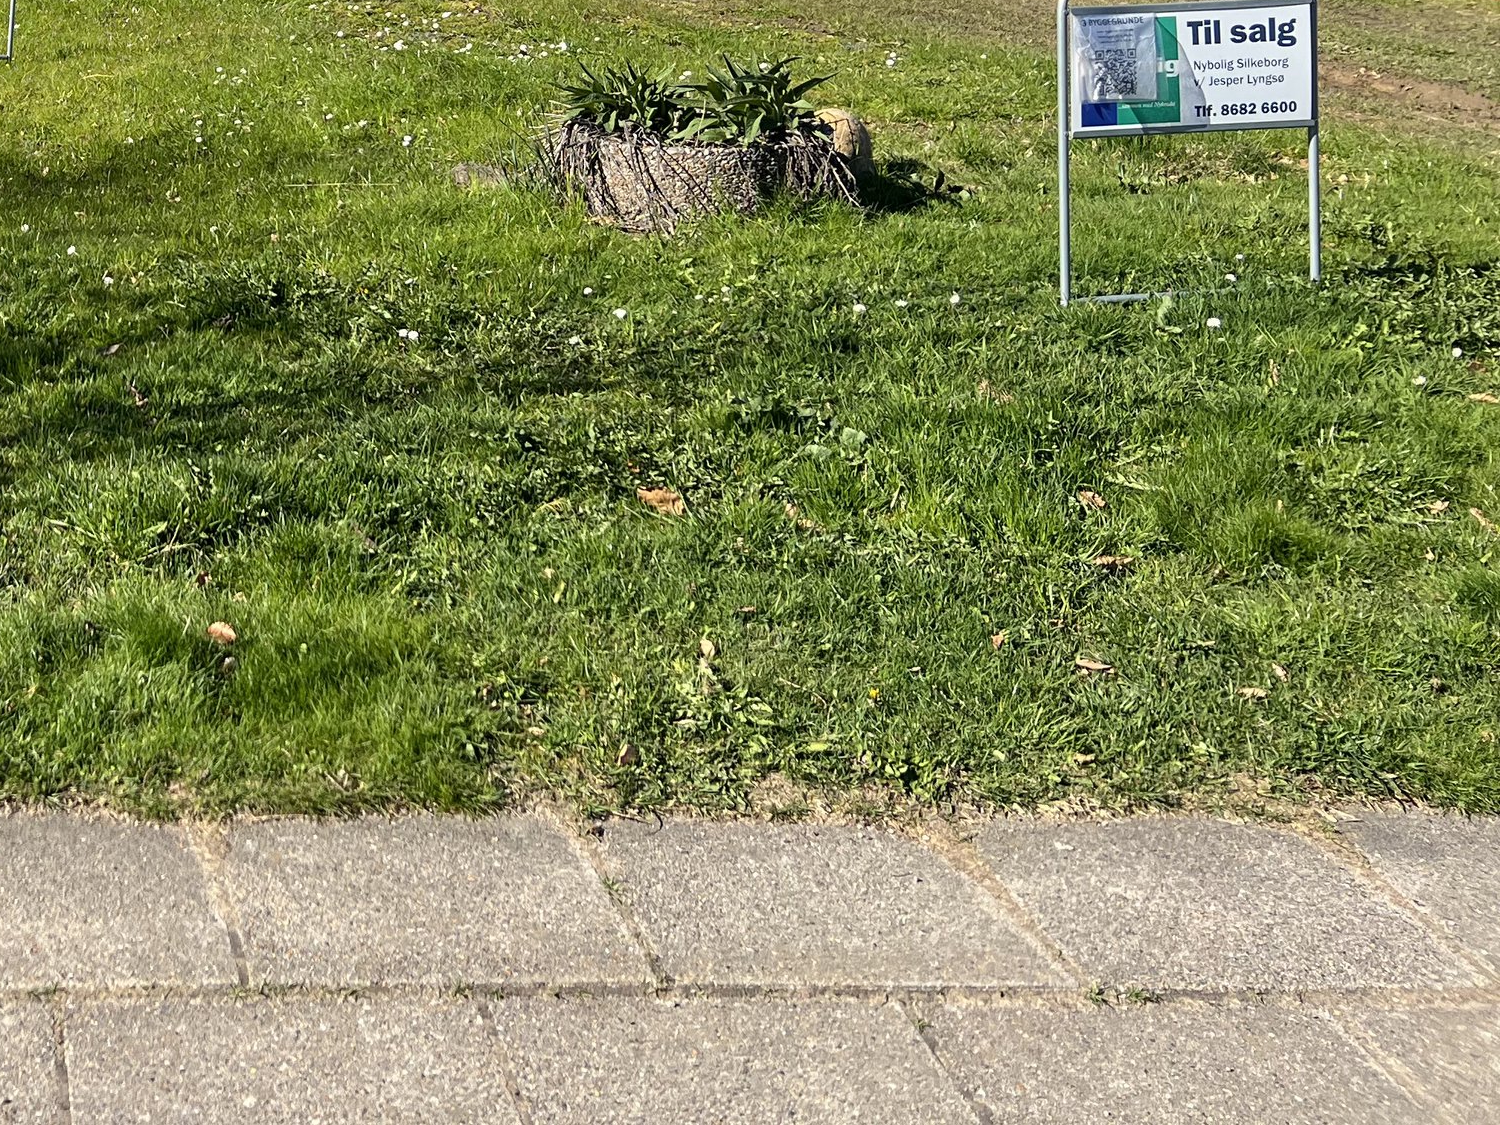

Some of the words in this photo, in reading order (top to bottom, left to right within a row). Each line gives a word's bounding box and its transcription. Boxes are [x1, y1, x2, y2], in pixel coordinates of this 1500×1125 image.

[1088, 16, 1144, 27] BYGGEGRUNDE
[1186, 19, 1222, 46] Til
[1230, 17, 1297, 47] salg
[1193, 59, 1235, 72] Nybolig
[1236, 57, 1289, 70] Silkeborg
[1193, 75, 1204, 87] v/
[1208, 77, 1246, 89] Jesper
[1247, 74, 1285, 86] Lyngsø
[1194, 105, 1217, 118] Tlf.
[1221, 103, 1258, 117] 8682
[1260, 100, 1298, 114] 6600
